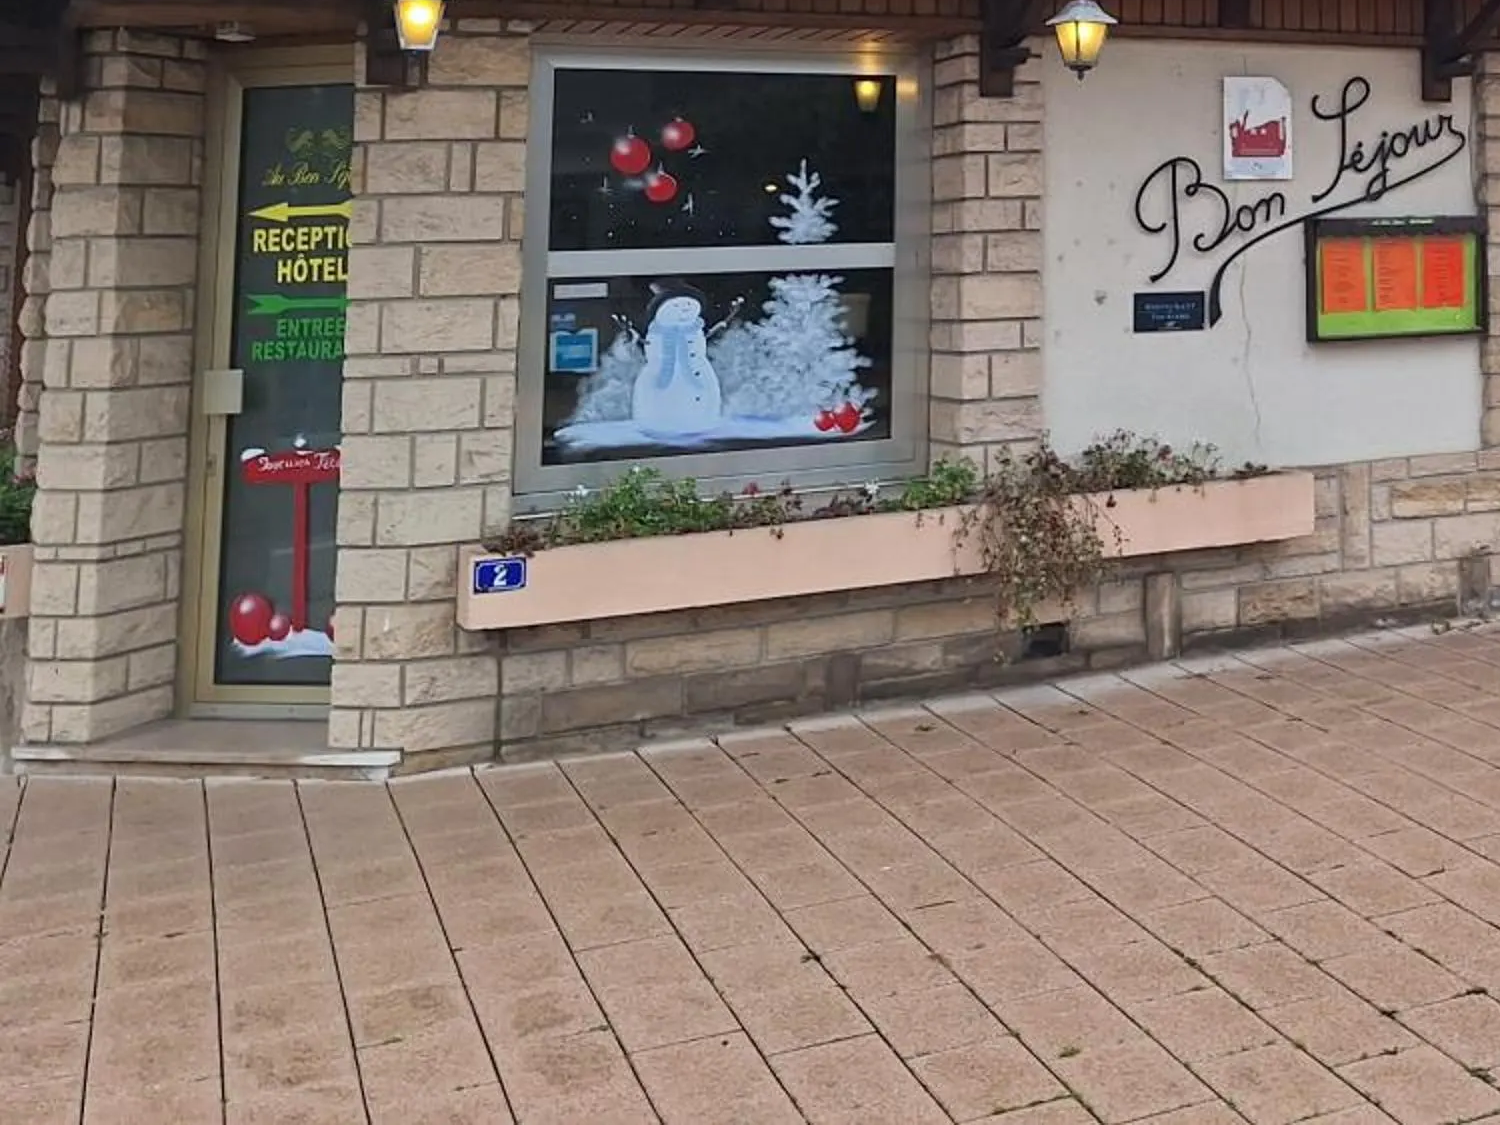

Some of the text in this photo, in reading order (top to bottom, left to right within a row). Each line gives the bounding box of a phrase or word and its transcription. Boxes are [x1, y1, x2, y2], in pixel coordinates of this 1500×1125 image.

[1135, 156, 1286, 283] Bon
[1311, 76, 1465, 202] Séjour
[277, 254, 348, 283] HÔTEL
[491, 563, 508, 587] 2
